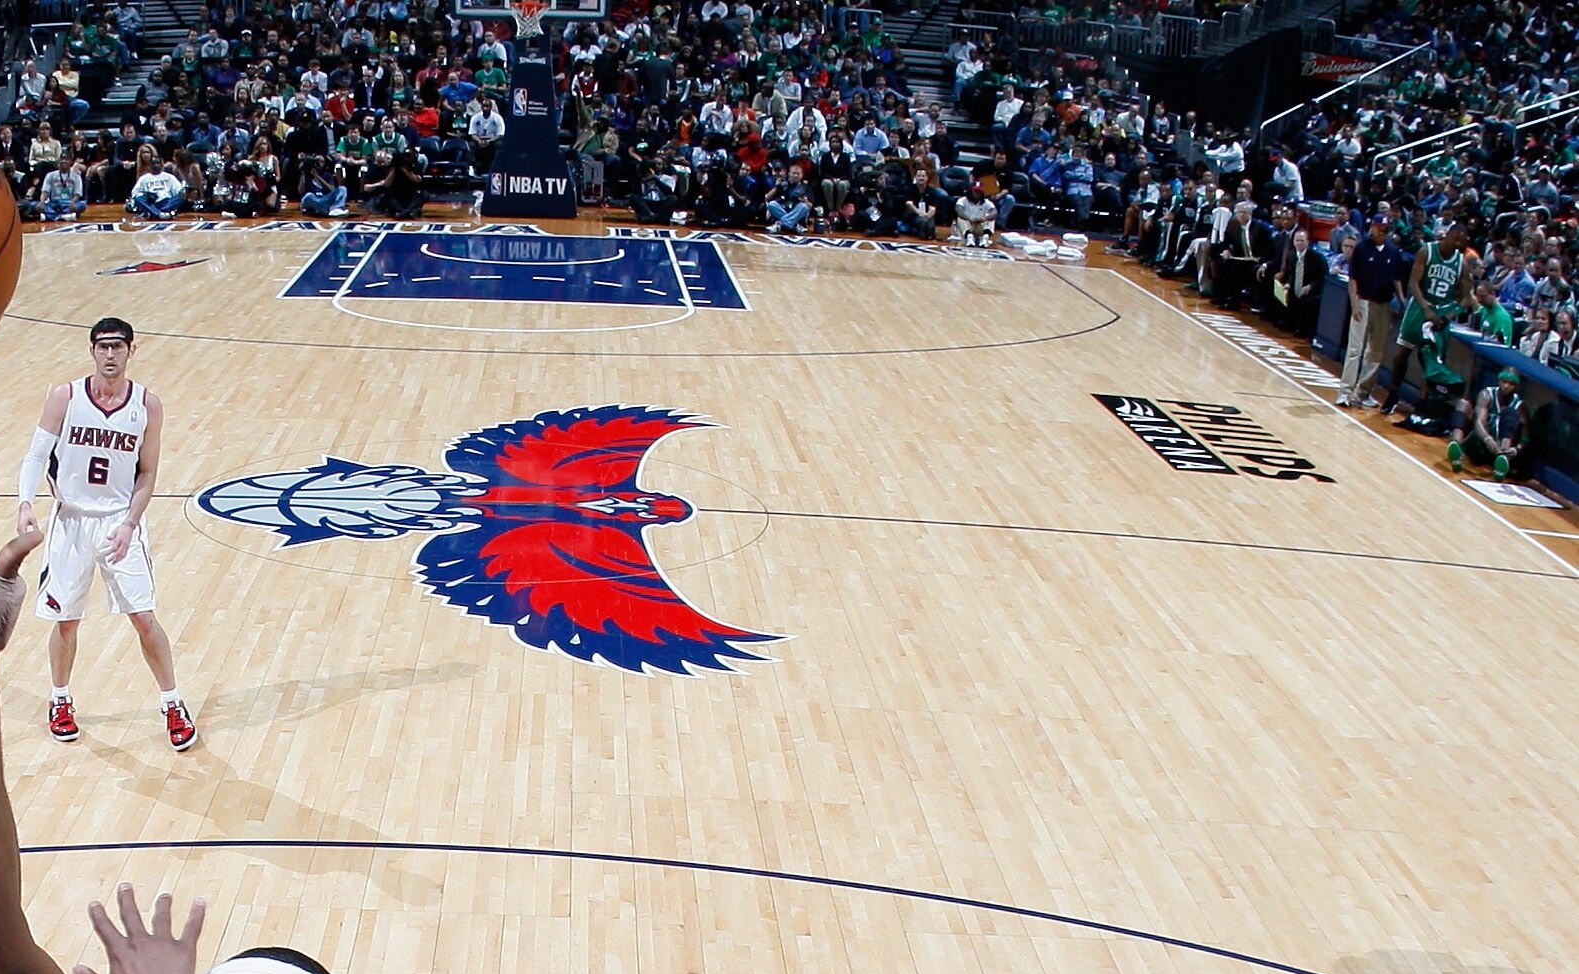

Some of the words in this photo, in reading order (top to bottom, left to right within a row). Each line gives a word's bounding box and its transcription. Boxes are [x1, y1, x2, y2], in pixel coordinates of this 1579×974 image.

[1301, 59, 1377, 76] Budweiser
[509, 176, 543, 194] NBA
[545, 178, 567, 195] TV
[1427, 278, 1449, 298] 12
[68, 426, 138, 452] HAWKS
[1117, 412, 1227, 469] ARENA
[1155, 399, 1338, 483] PHILIPS
[88, 456, 110, 485] 6
